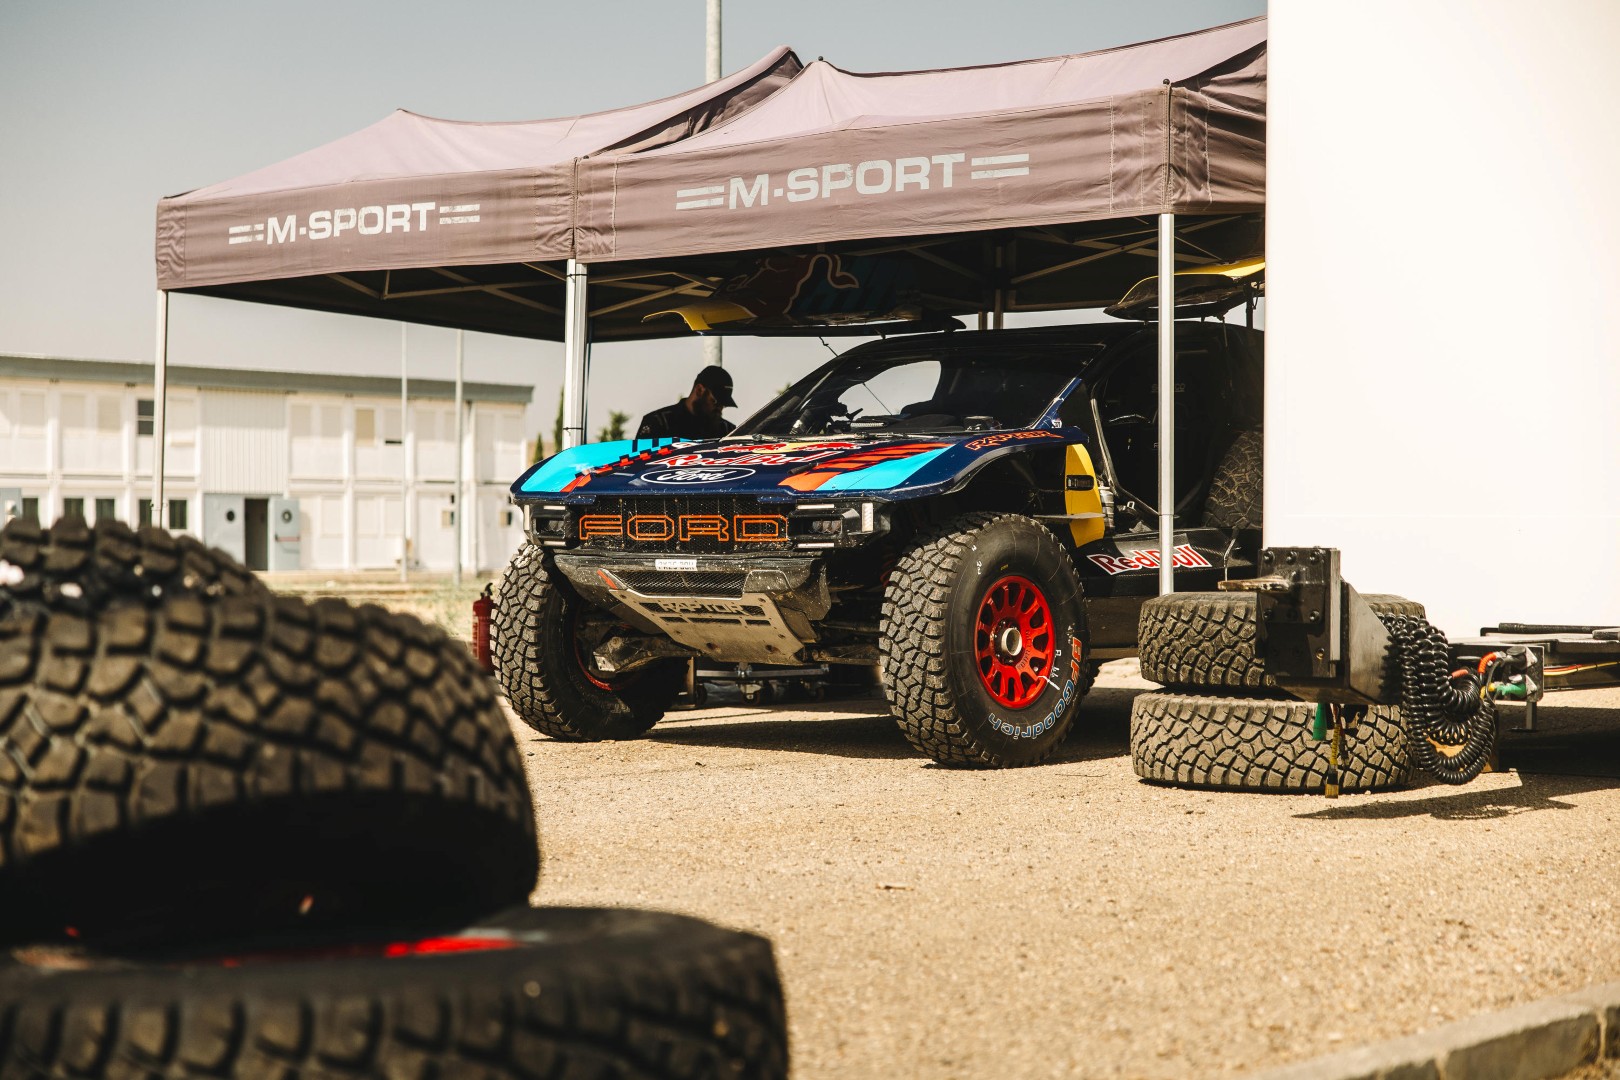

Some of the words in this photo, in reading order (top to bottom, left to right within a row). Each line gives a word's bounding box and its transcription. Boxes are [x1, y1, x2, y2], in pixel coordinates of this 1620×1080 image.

[728, 153, 967, 210] M-SPORT
[266, 202, 437, 245] M-SPORT
[656, 469, 738, 482] Ford
[579, 514, 788, 542] FORD
[659, 602, 751, 616] RAPTOR
